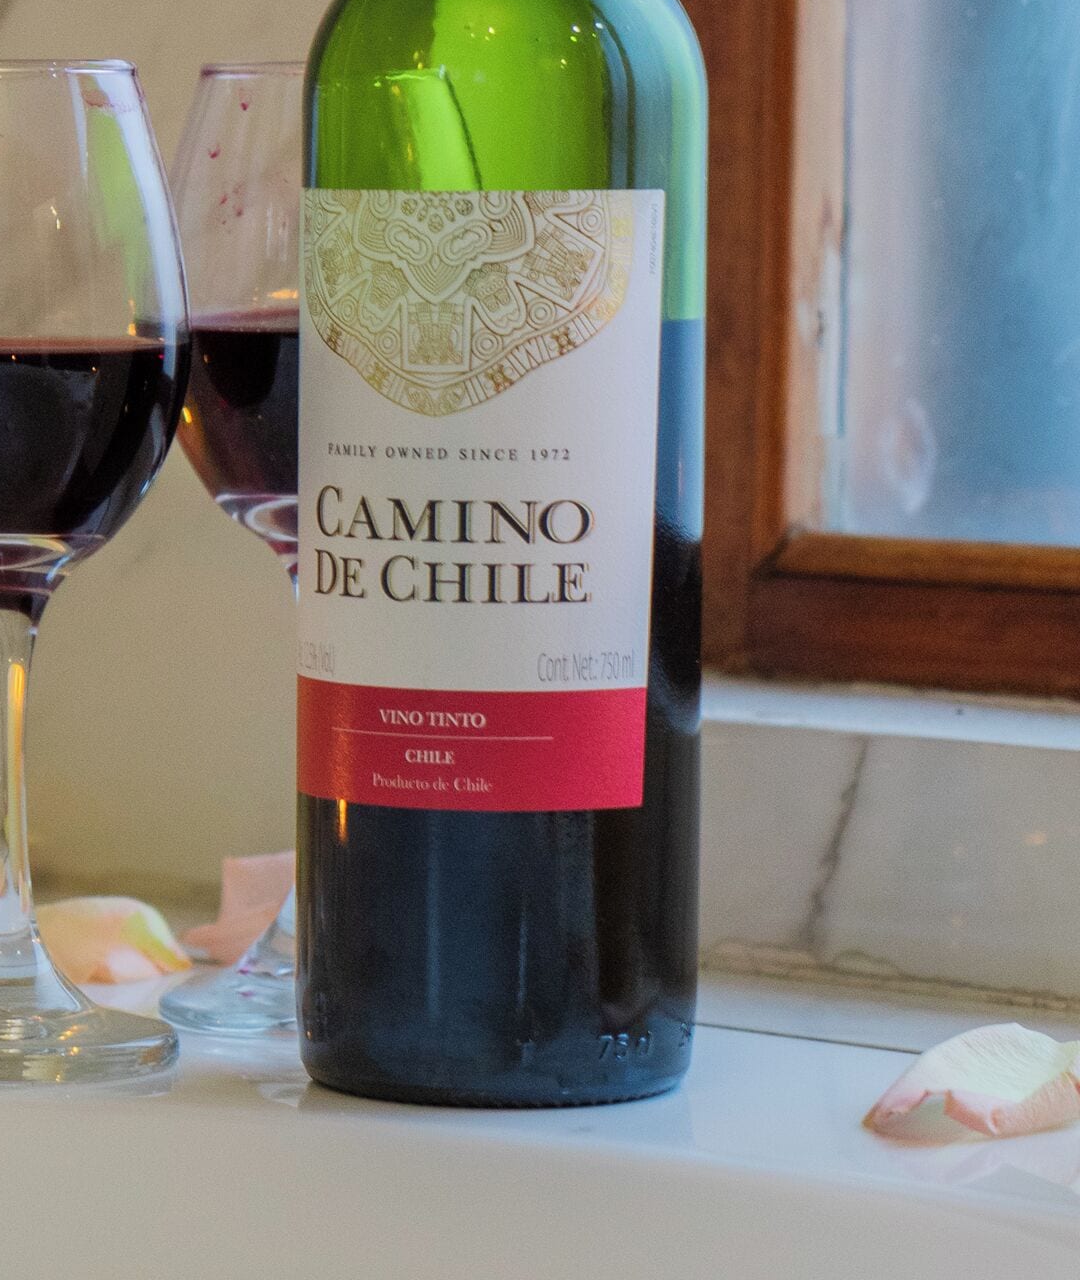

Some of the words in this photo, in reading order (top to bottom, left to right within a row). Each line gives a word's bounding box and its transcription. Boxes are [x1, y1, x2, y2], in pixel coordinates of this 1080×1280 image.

[327, 442, 376, 458] FAMILY
[385, 445, 448, 460] OWNED
[459, 447, 518, 462] SINCE
[530, 447, 571, 461] 1972
[316, 484, 595, 544] CAMINO
[314, 548, 366, 598] DE
[381, 554, 592, 604] CHILE
[601, 650, 620, 680] 750
[379, 709, 423, 726] VINO
[426, 711, 486, 728] TINTO
[405, 749, 454, 764] CHILE
[372, 772, 429, 791] Producto
[433, 777, 449, 791] de
[453, 777, 492, 793] Chile
